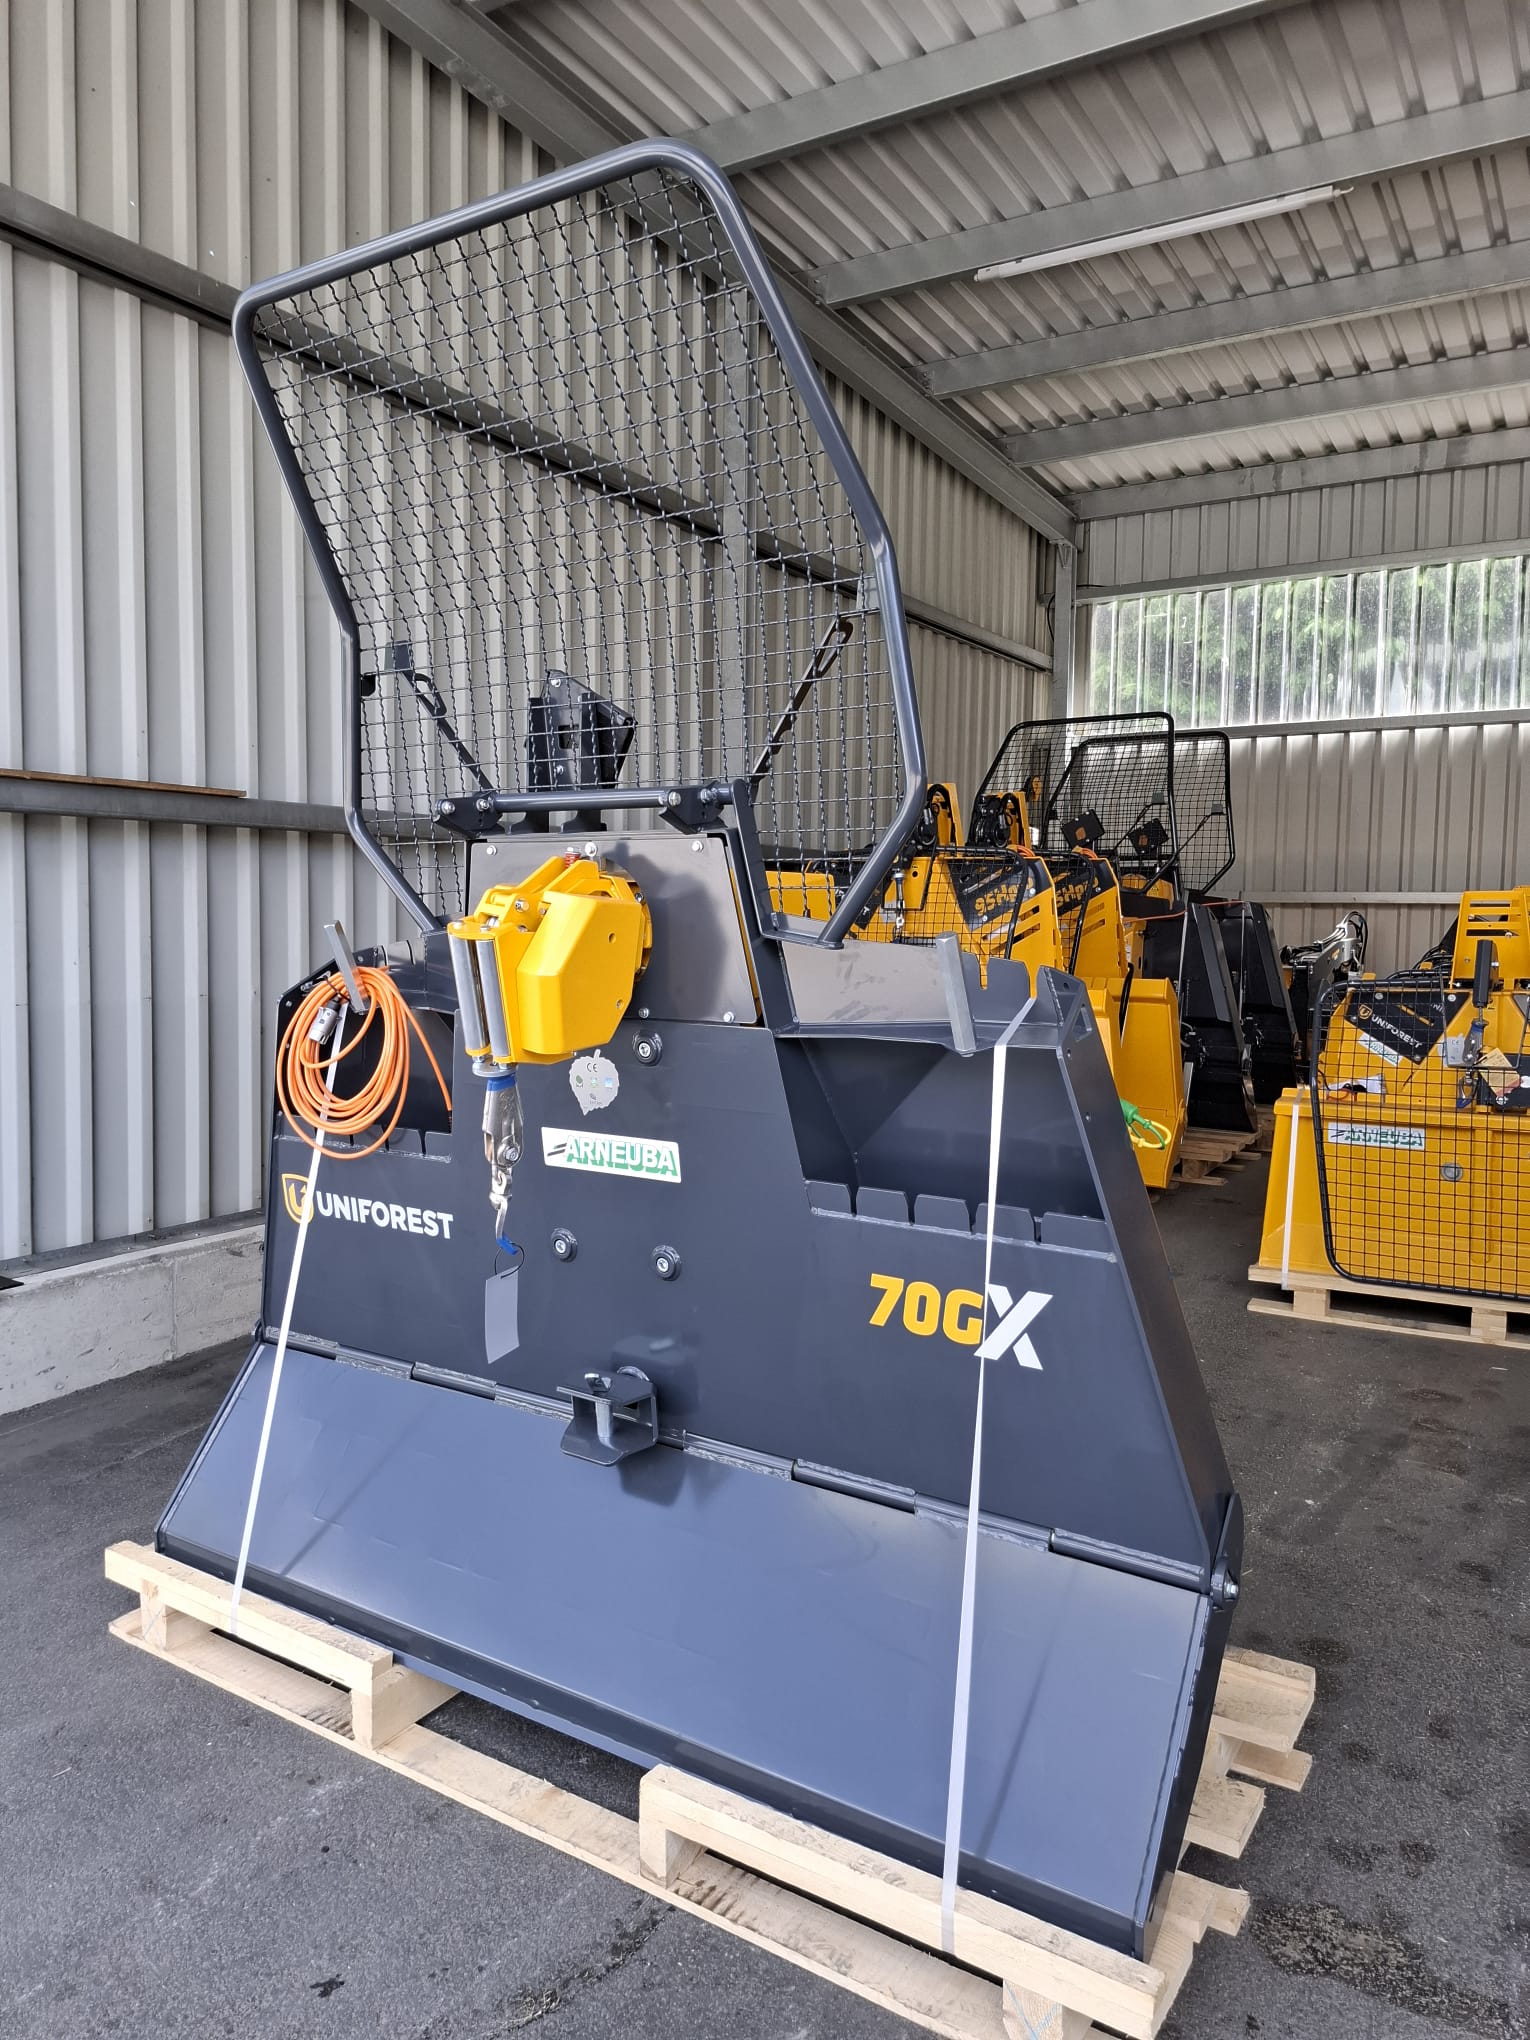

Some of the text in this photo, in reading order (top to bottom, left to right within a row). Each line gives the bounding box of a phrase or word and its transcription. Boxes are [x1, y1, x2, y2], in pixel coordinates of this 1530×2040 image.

[975, 877, 1034, 916] 95Hpo
[1371, 1013, 1422, 1049] UNIFOREST
[565, 1135, 678, 1176] ARNEUBA
[316, 1190, 454, 1239] UNIFOREST
[869, 1273, 1054, 1371] 70GX
